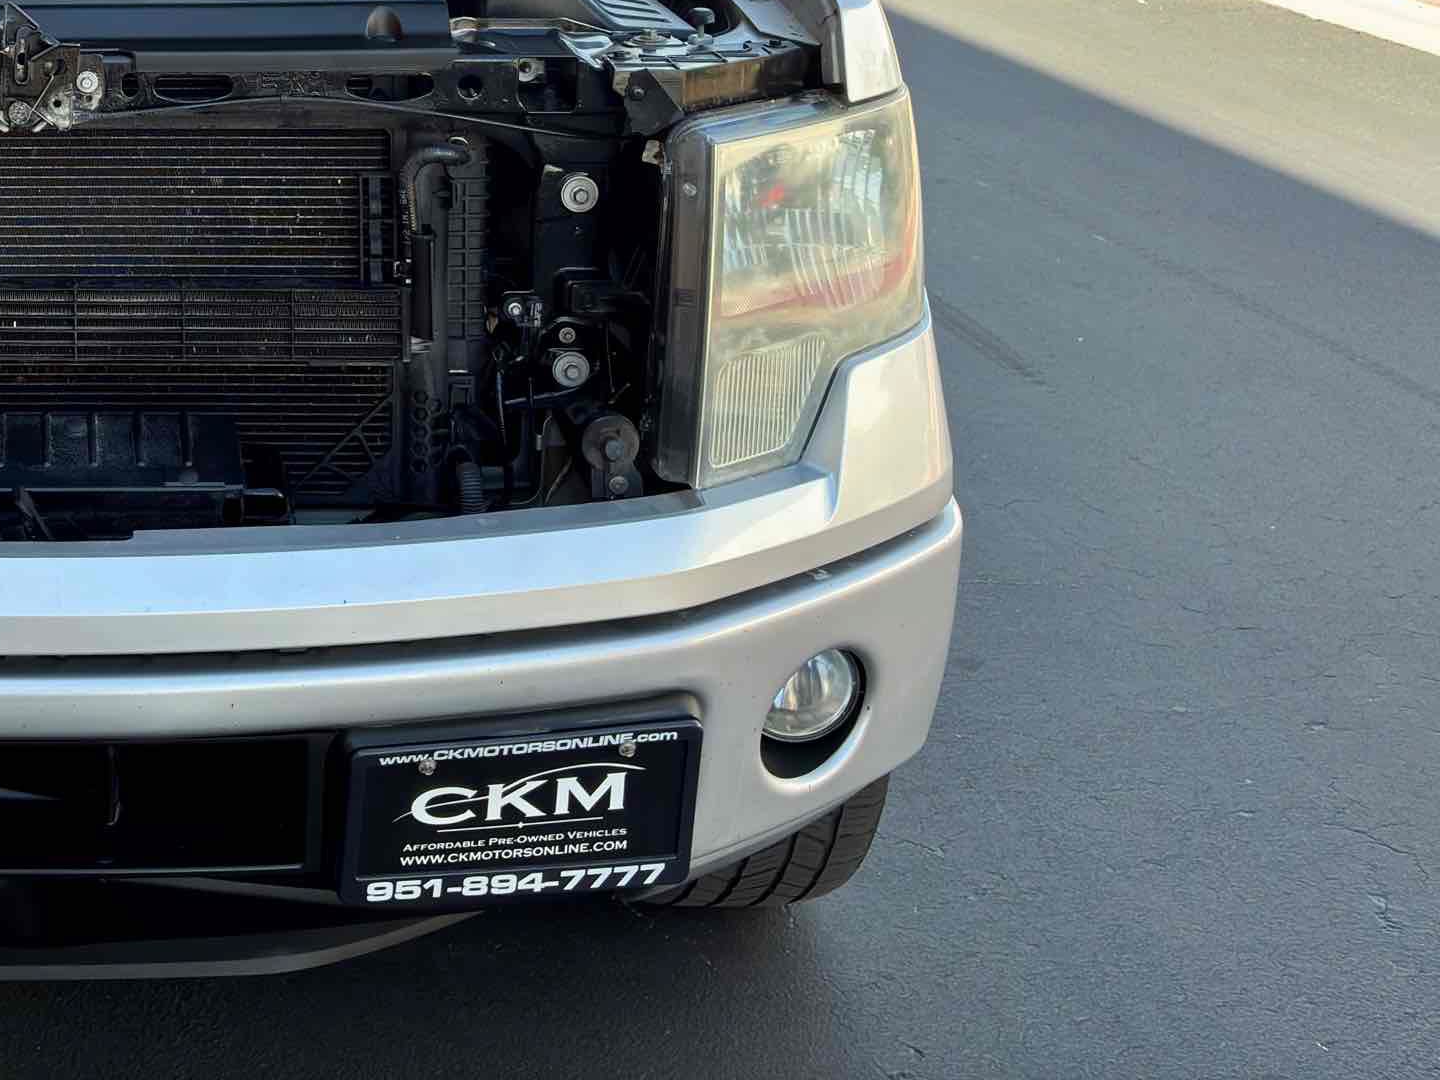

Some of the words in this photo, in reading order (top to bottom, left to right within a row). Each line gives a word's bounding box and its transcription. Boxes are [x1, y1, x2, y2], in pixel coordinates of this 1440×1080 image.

[379, 731, 678, 766] www.CKMOTORSONLINE.com
[410, 771, 627, 825] CKM
[400, 839, 628, 866] WWW.CKMOTORSONLINE.COM
[366, 863, 666, 902] 951-894-7777
